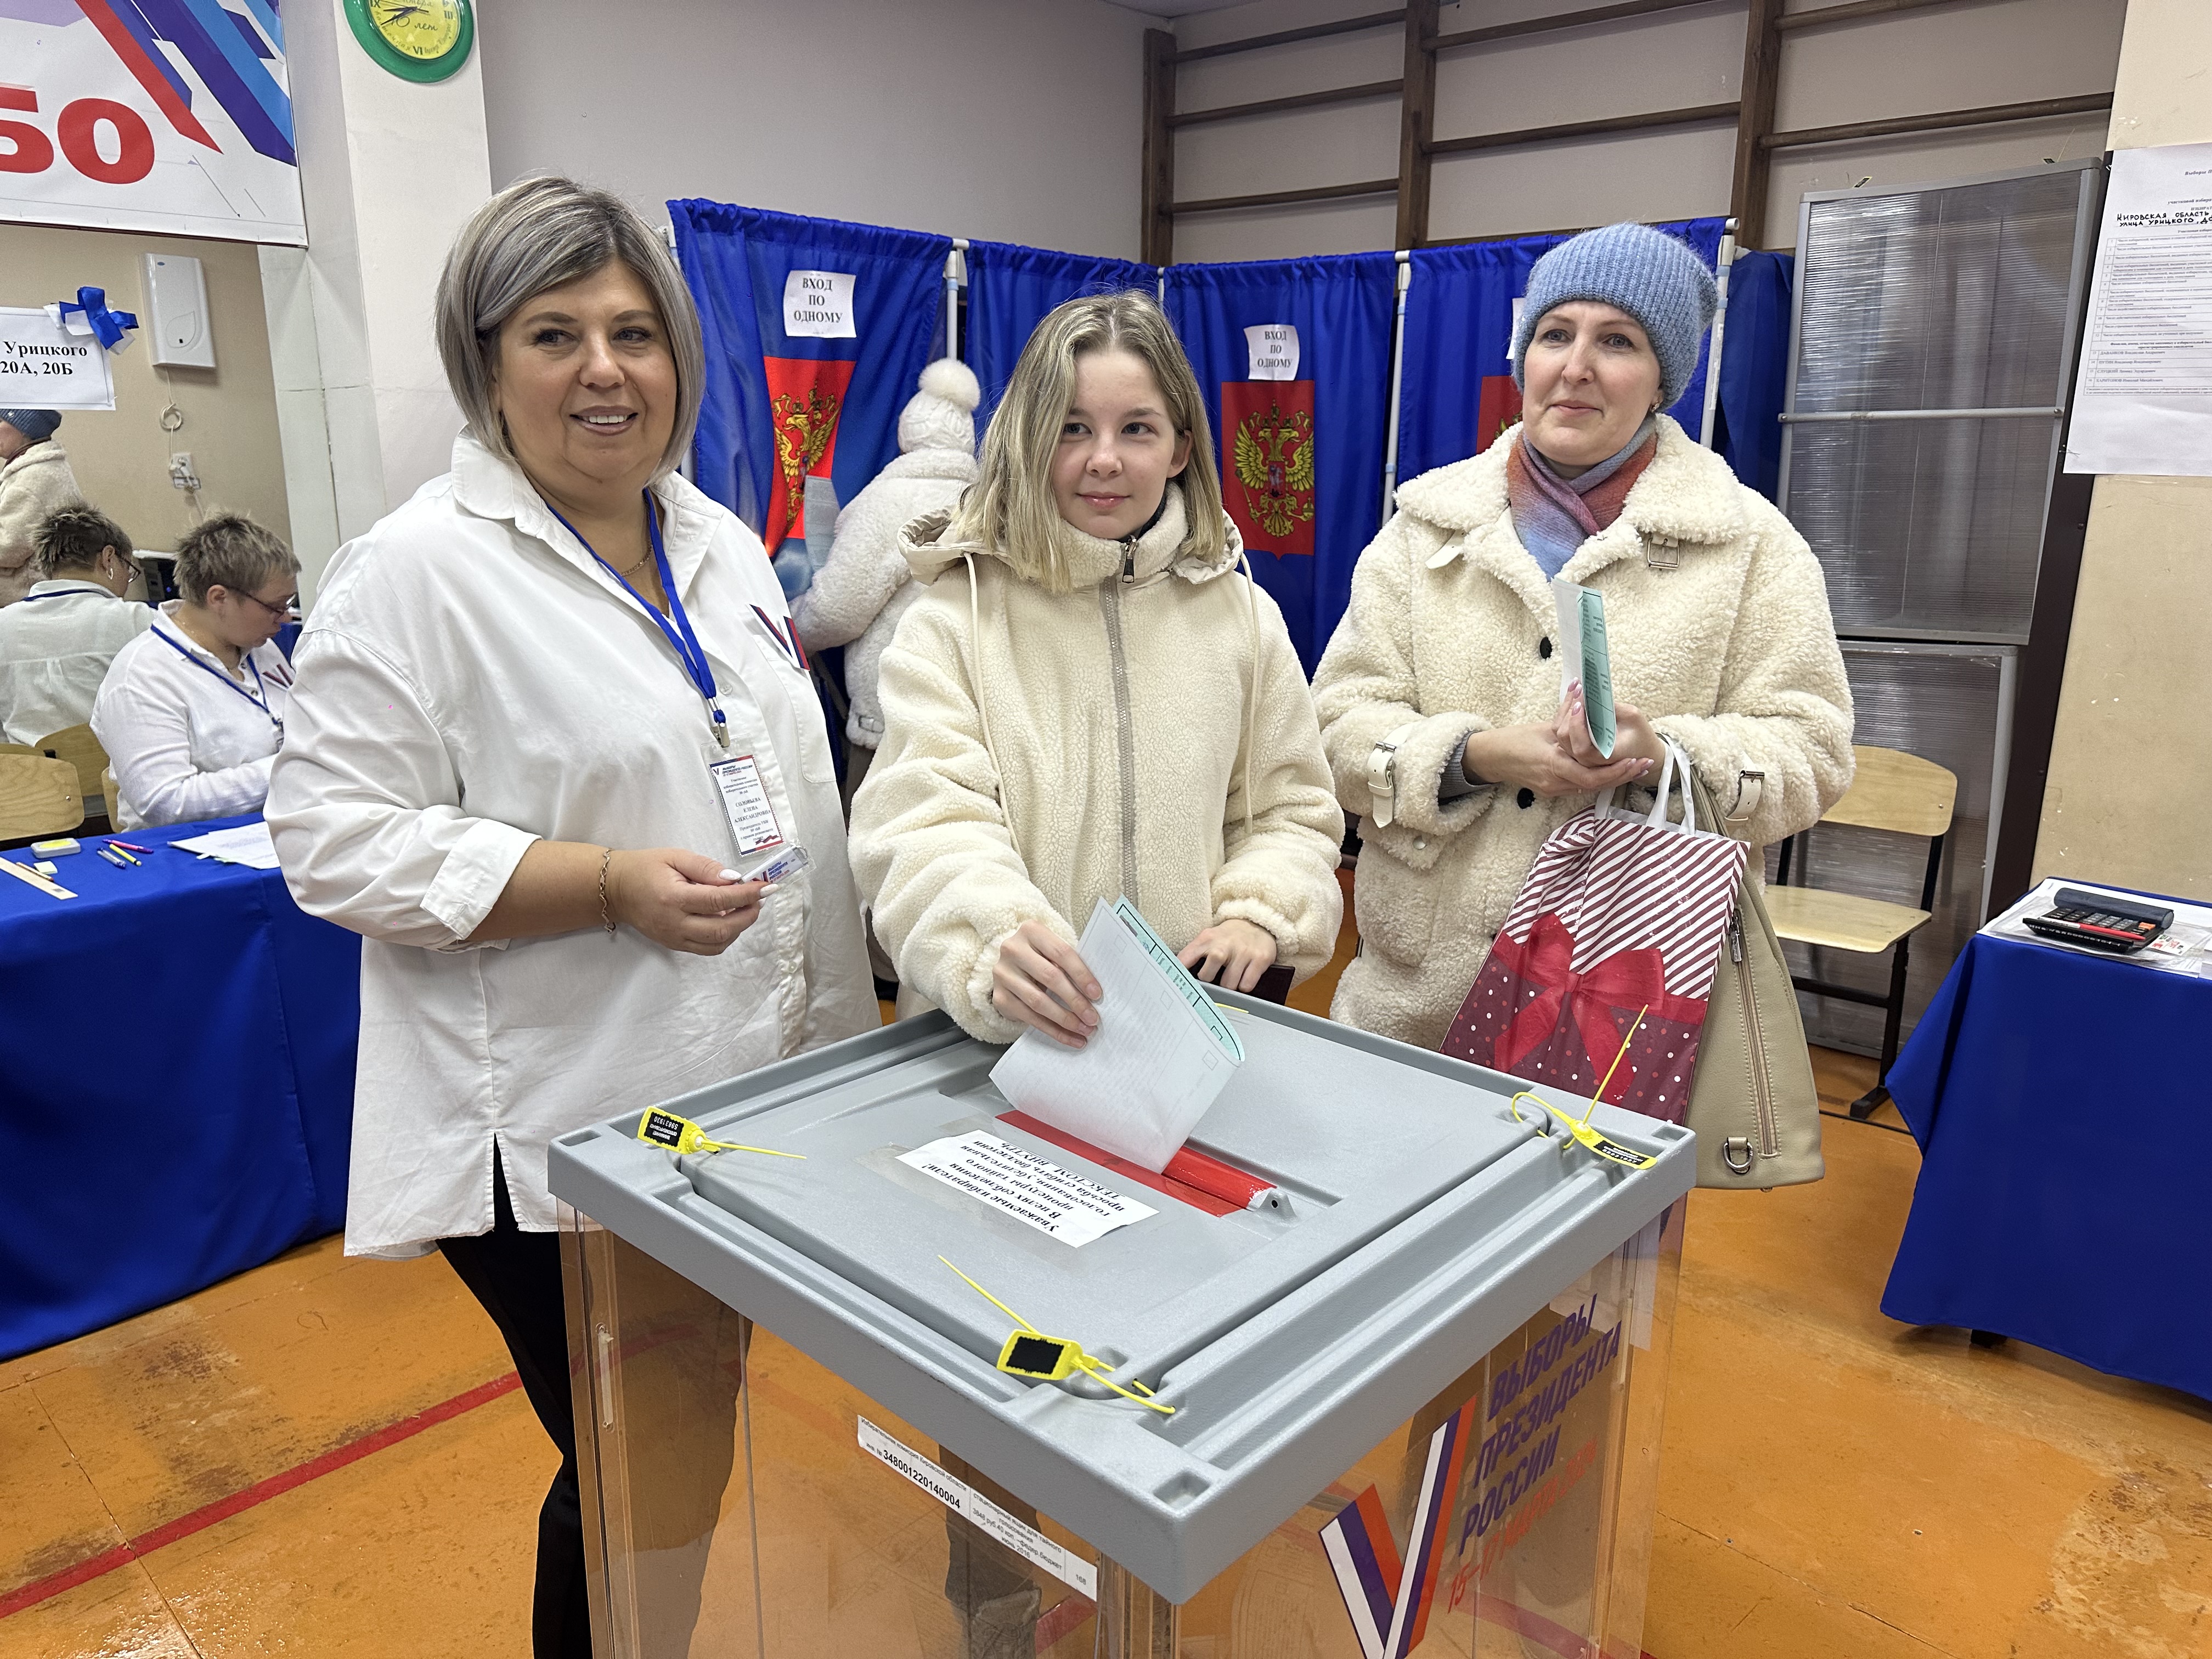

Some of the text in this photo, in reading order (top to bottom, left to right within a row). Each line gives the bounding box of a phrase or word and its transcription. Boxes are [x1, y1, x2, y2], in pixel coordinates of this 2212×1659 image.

[802, 277, 833, 292] ВХОД
[809, 295, 825, 306] ПО
[794, 310, 843, 323] ОДНОМУ
[1265, 331, 1287, 341] ВХОД
[0, 360, 74, 377] 20А, 20Б
[3, 341, 88, 358] Урицкого
[1257, 358, 1293, 368] ОДНОМУ
[1270, 345, 1282, 354] ПО
[949, 1163, 1063, 1220] В целях соблюдения
[960, 1146, 1111, 1216] голосования, убедительная
[966, 1159, 1075, 1210] процедуры тайного
[973, 1141, 1126, 1211] просьба сгибать бюллетени
[1001, 1143, 1120, 1200] ТЕКСТОМ ВНУТРЬ
[922, 1163, 1059, 1232] Уважаемые избиратели!
[1487, 1293, 1598, 1423] ВЫБОРЫ
[1472, 1319, 1622, 1491] ПРЕЗИДЕНТА
[883, 1449, 961, 1509] 348001220140004
[946, 1474, 967, 1492] области
[1458, 1423, 1562, 1558] РОССИИ
